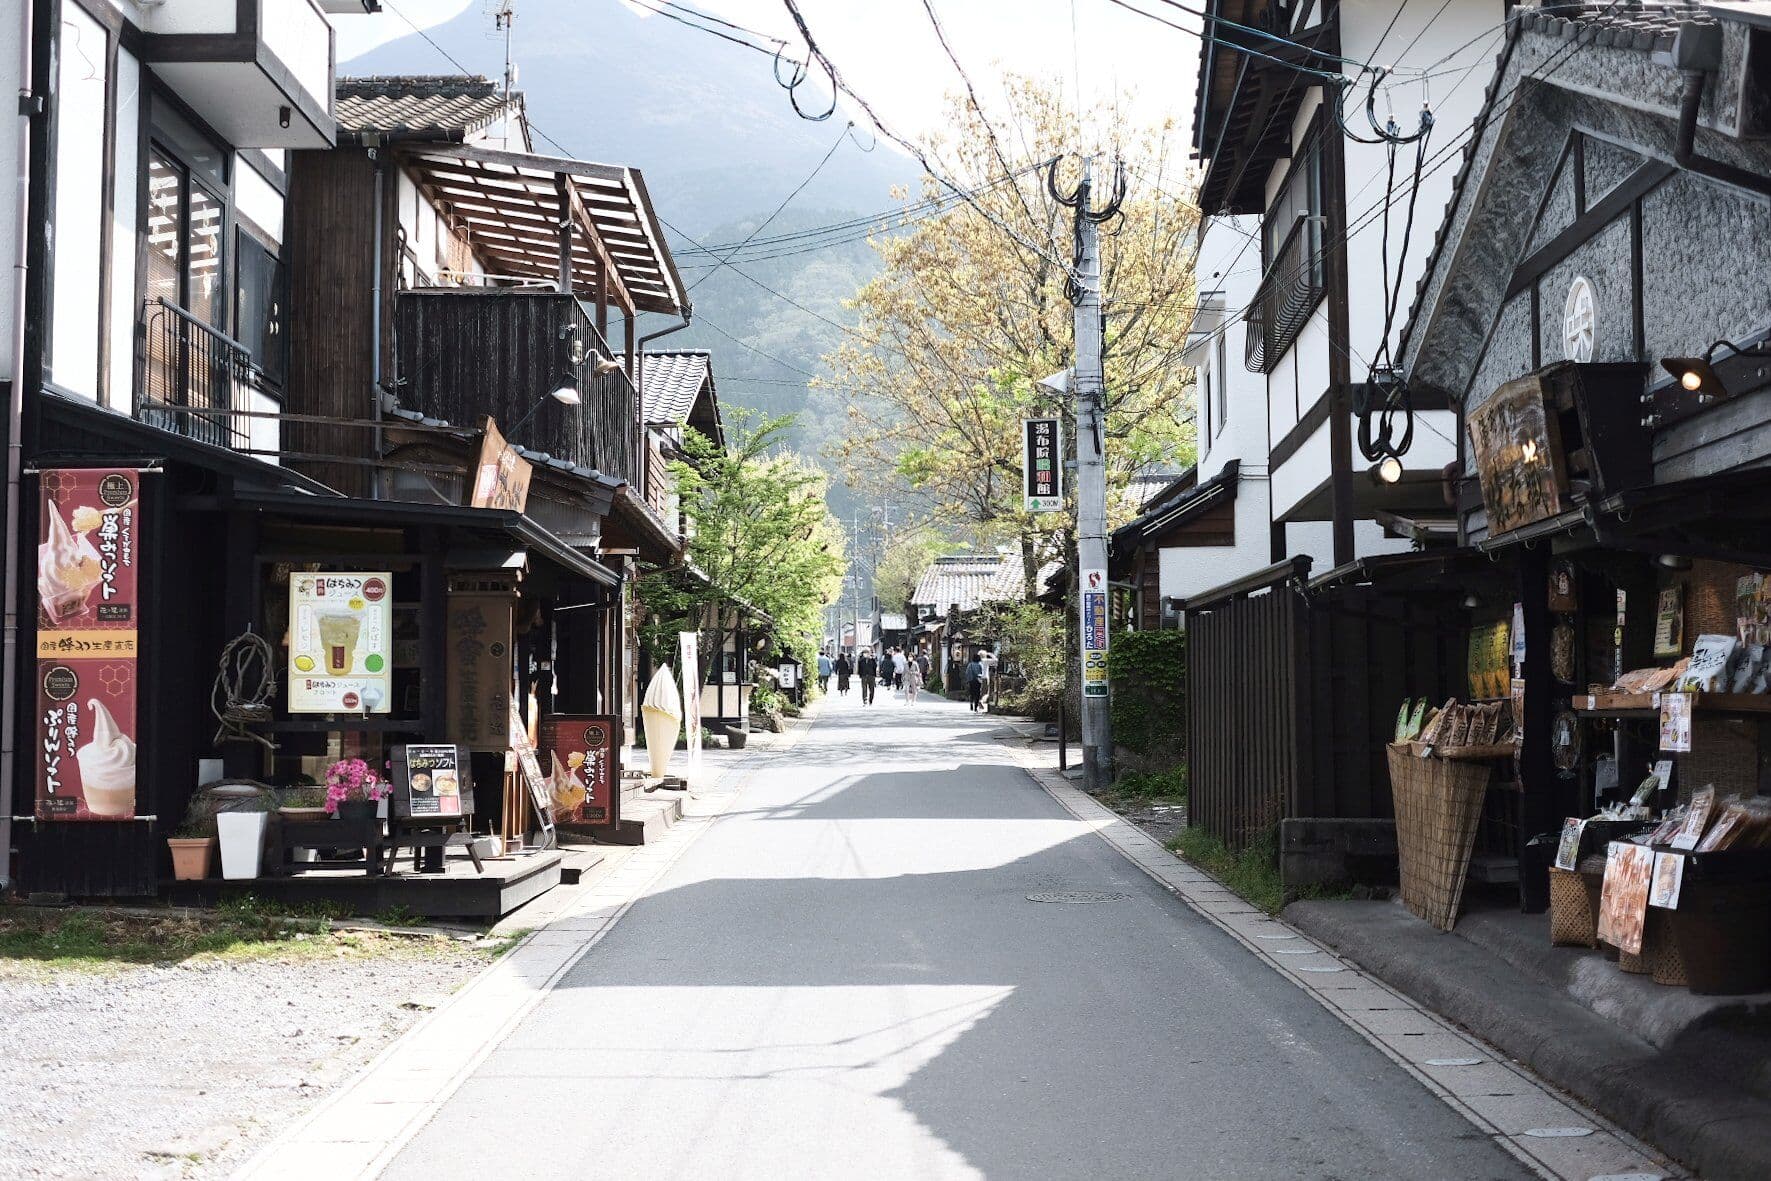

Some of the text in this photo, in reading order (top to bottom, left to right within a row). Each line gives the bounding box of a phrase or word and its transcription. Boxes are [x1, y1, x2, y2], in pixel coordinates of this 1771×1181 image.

[326, 578, 362, 589] はちみつ
[329, 589, 359, 598] ジュース
[410, 757, 455, 769] はちみつソフト
